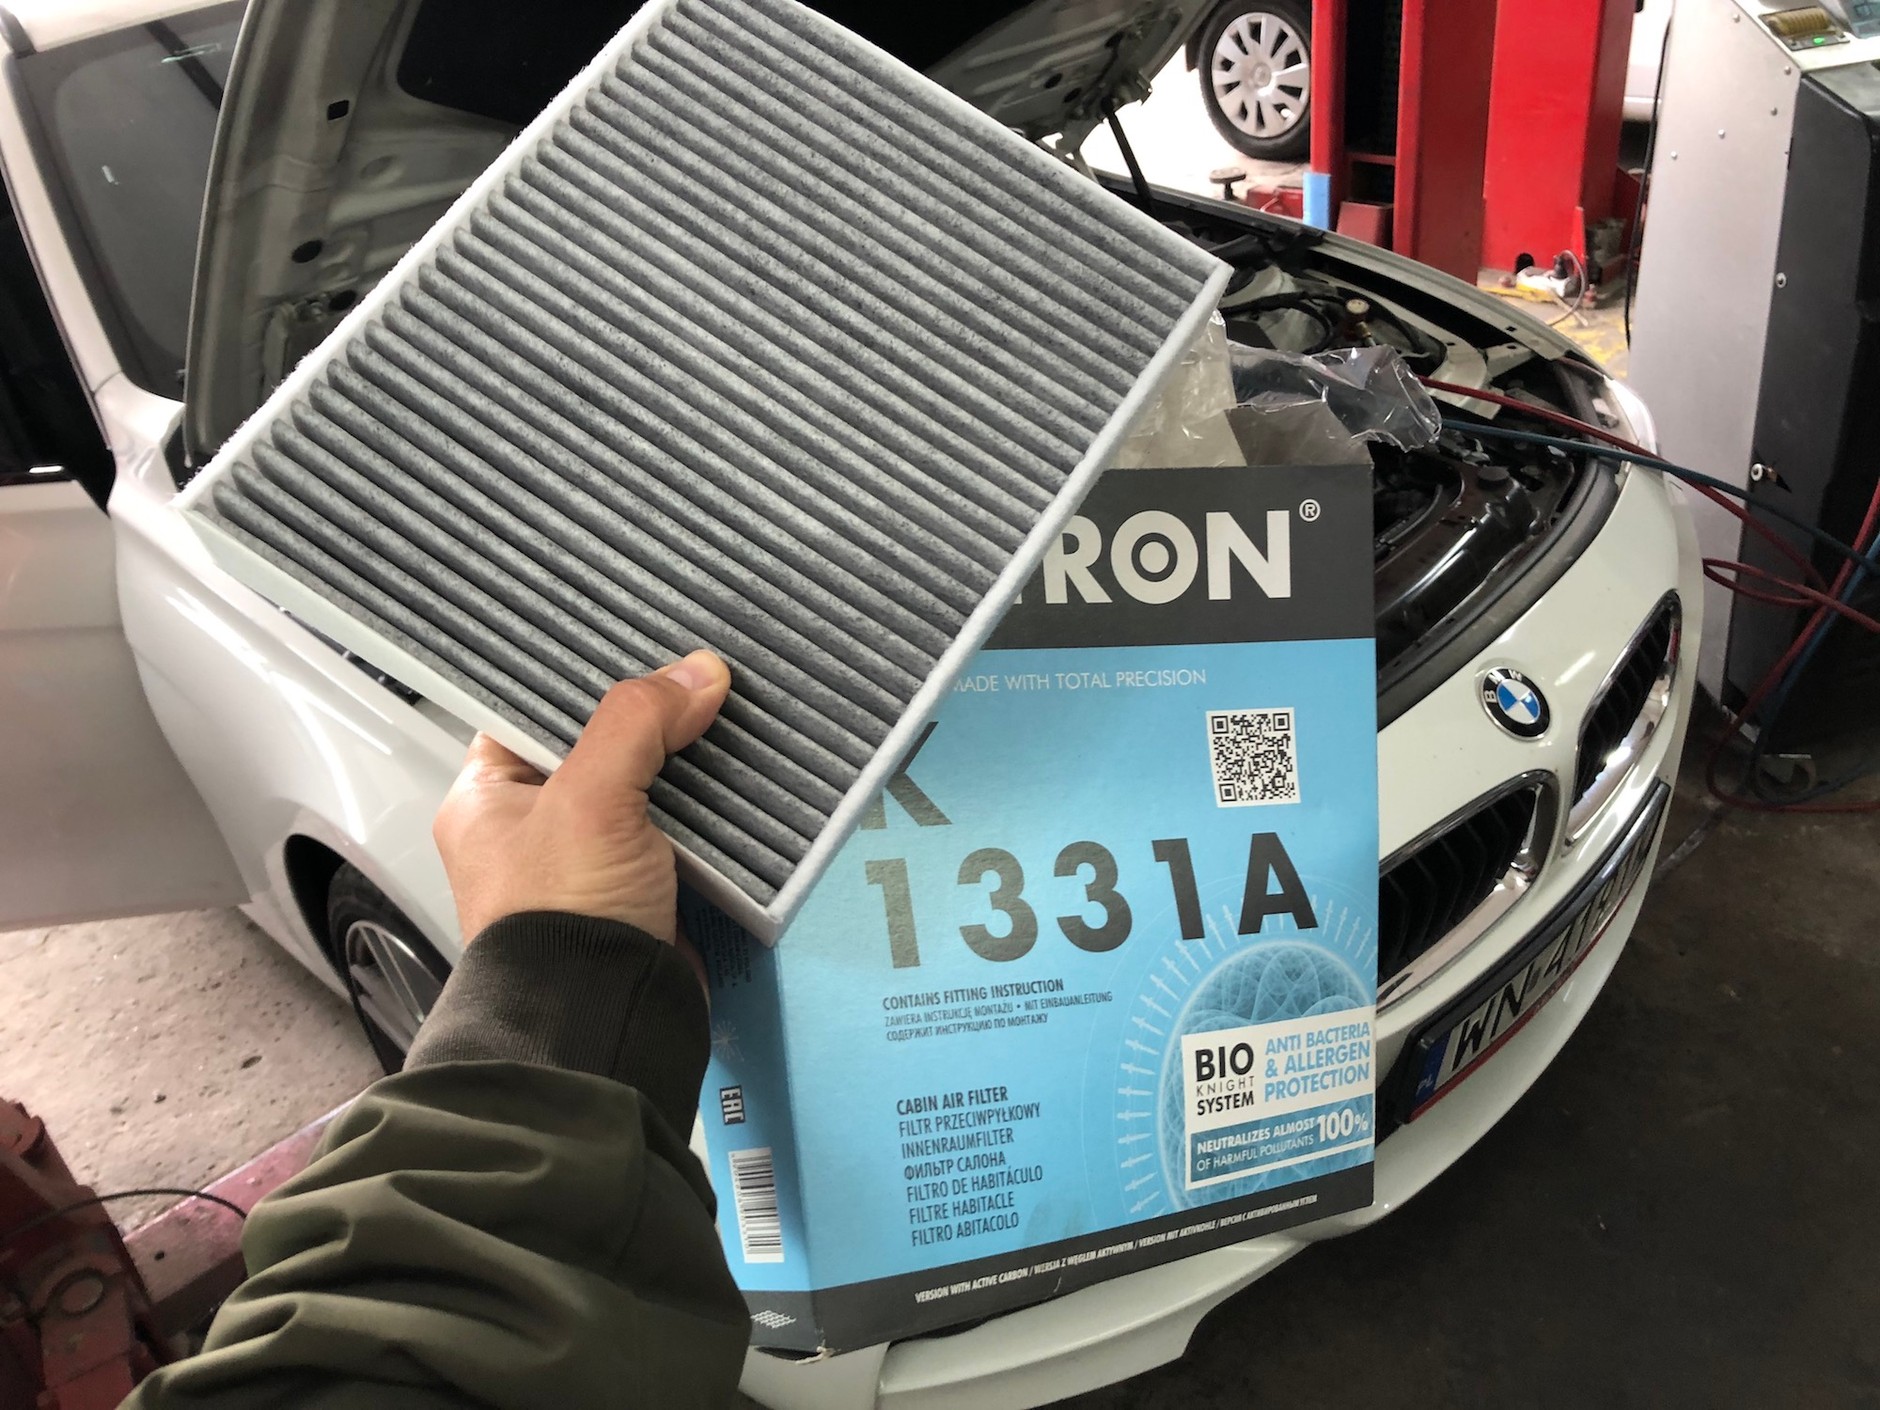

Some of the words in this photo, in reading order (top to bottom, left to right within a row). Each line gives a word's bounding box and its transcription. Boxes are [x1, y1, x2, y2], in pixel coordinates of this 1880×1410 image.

[1013, 510, 1291, 605] RON
[1004, 673, 1050, 691] WITH
[1055, 672, 1112, 690] TOTAL
[1116, 668, 1207, 688] PRECISION
[1484, 668, 1523, 704] BMW
[860, 721, 952, 830] K
[865, 832, 1319, 968] 1331A
[882, 991, 941, 1011] CONTAINS
[943, 986, 988, 1004] FITTING
[990, 978, 1064, 999] INSTRUCTION
[884, 1013, 923, 1028] ZAWIERA
[1024, 999, 1039, 1012] MIT
[1040, 991, 1113, 1010] EINBAUANLEITUNG
[886, 1025, 934, 1043] СОДЕРЖИТ
[935, 1019, 993, 1037] ИНСТРУКЦИЮ
[993, 1017, 1006, 1029] ПО
[1007, 1012, 1049, 1028] МОНТАЖУ
[1452, 961, 1536, 1072] WN
[1264, 1033, 1302, 1056] ANTI
[1306, 1021, 1371, 1048] BACTERIA
[1194, 1042, 1255, 1083] BIO
[1264, 1058, 1279, 1079] &
[1284, 1040, 1371, 1075] ALLERGEN
[896, 1094, 939, 1116] CABIN
[942, 1090, 965, 1110] AIR
[968, 1085, 1009, 1107] FILTER
[1196, 1075, 1255, 1097] KNIGHT
[1264, 1062, 1370, 1103] PROTECTION
[721, 1087, 745, 1125] EAC
[898, 1118, 933, 1138] FILTR
[935, 1102, 1042, 1133] PRZECIWPYŁKOWY
[1196, 1091, 1255, 1116] SYSTEM
[901, 1127, 1015, 1160] INNENRAUMFILTER
[1196, 1126, 1271, 1156] NEUTRALIZES
[1272, 1116, 1316, 1139] ALMOST
[1316, 1108, 1369, 1143] 100%
[904, 1158, 955, 1181] ФИЛЬТР
[957, 1151, 1007, 1173] САЛОНА
[1196, 1158, 1212, 1173] OF
[1212, 1149, 1258, 1169] HARMFUL
[1259, 1134, 1314, 1157] POLLUTANTS
[906, 1182, 949, 1203] FILTRO
[952, 1178, 968, 1196] DE
[971, 1165, 1044, 1192] HABITÁCULO
[909, 1204, 950, 1225] FILTRE
[952, 1191, 1016, 1217] HABITACLE
[911, 1226, 953, 1247] FILTRO
[956, 1211, 1019, 1239] ABITACOLO
[914, 1283, 949, 1304] VERSION
[950, 1280, 971, 1296] WITH
[972, 1274, 998, 1290] ACTIVE
[998, 1266, 1029, 1284] CARBON
[1060, 1257, 1067, 1268] Z
[1138, 1233, 1167, 1249] VERSION
